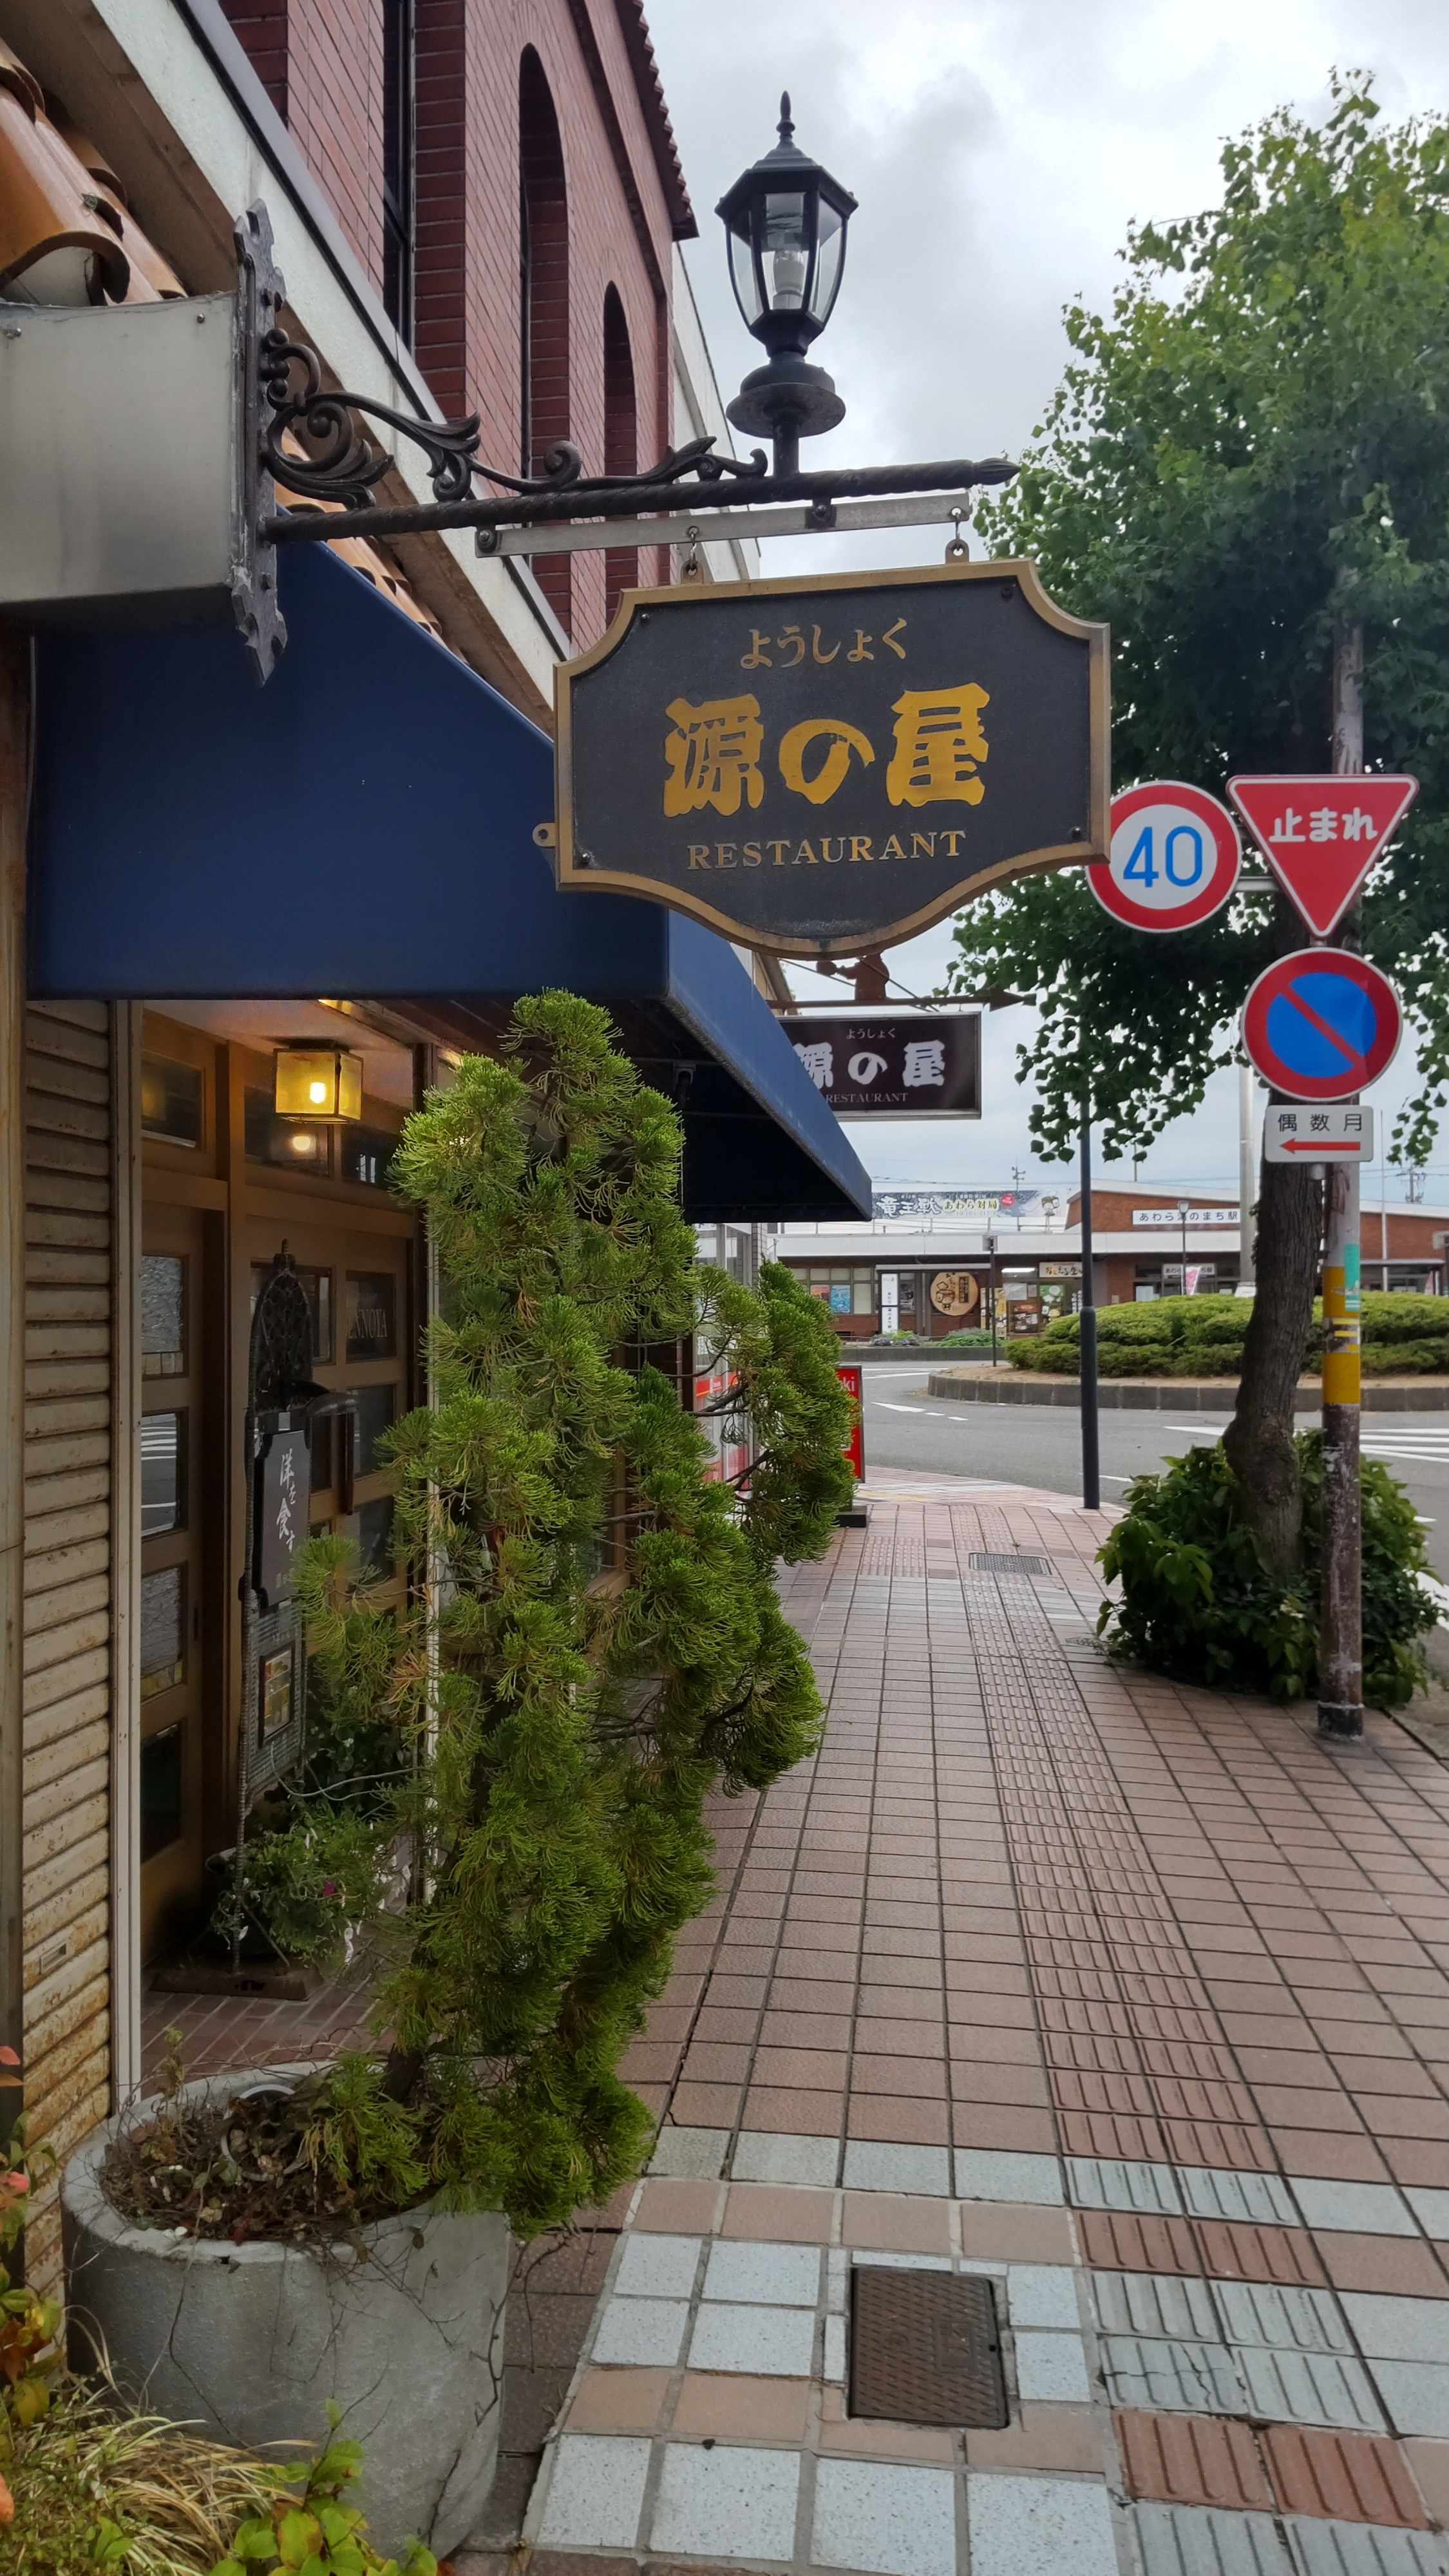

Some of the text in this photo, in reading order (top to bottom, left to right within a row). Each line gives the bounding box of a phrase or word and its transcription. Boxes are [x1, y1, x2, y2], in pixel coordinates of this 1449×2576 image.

[740, 618, 907, 669] ようしょく
[663, 683, 990, 817] 源の屋
[1269, 806, 1378, 842] 止まれ
[686, 830, 966, 870] RESTAURANT
[1123, 826, 1202, 887] 40
[846, 1027, 896, 1039] ようしょく
[826, 1092, 909, 1103] RESTAURANT
[1278, 1113, 1362, 1132] 偶数月
[276, 1448, 296, 1553] 洋を食す
